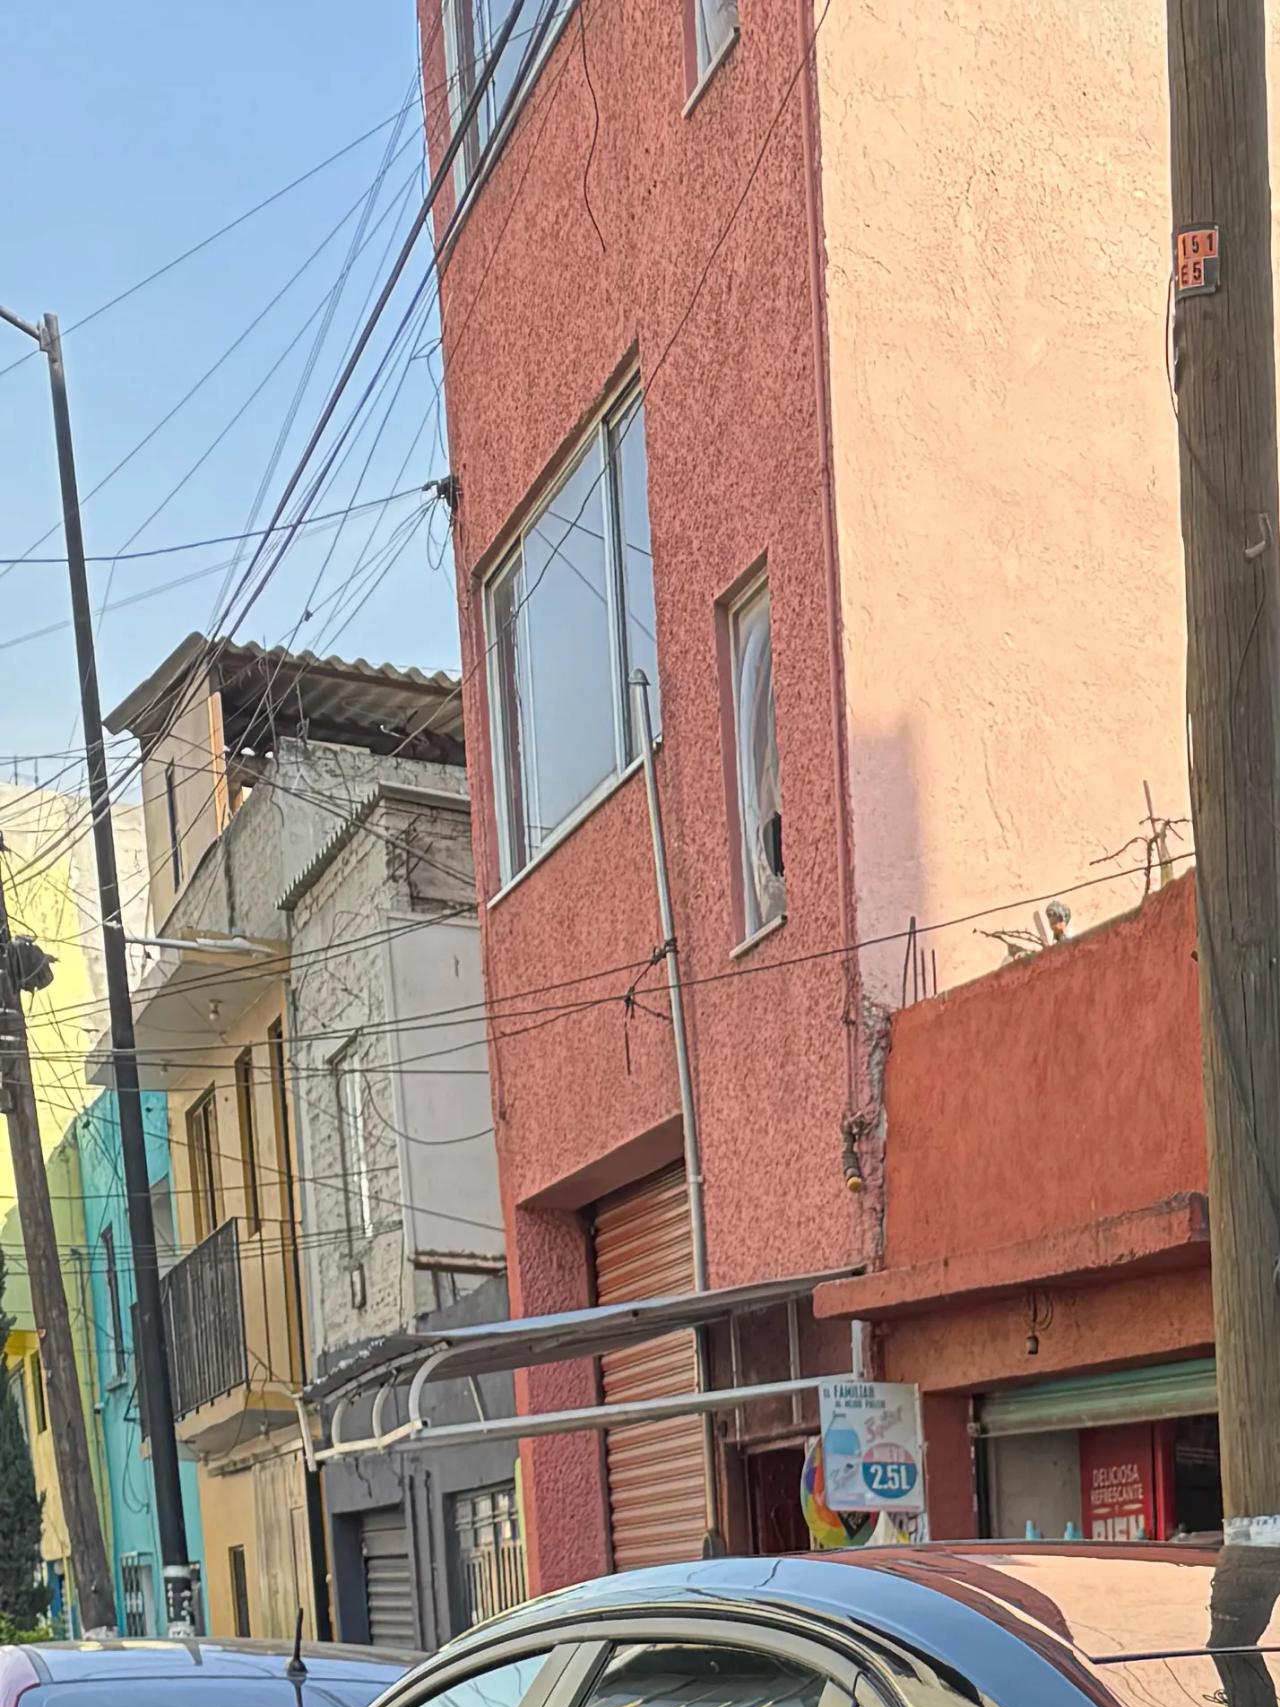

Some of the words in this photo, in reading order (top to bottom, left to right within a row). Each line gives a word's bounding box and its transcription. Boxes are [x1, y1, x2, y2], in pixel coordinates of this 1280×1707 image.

[834, 1385, 875, 1399] FAMILIAR
[870, 1464, 911, 1490] 2.5L
[1092, 1464, 1140, 1488] DELICIOSA
[1091, 1483, 1144, 1505] REFRESCANTE
